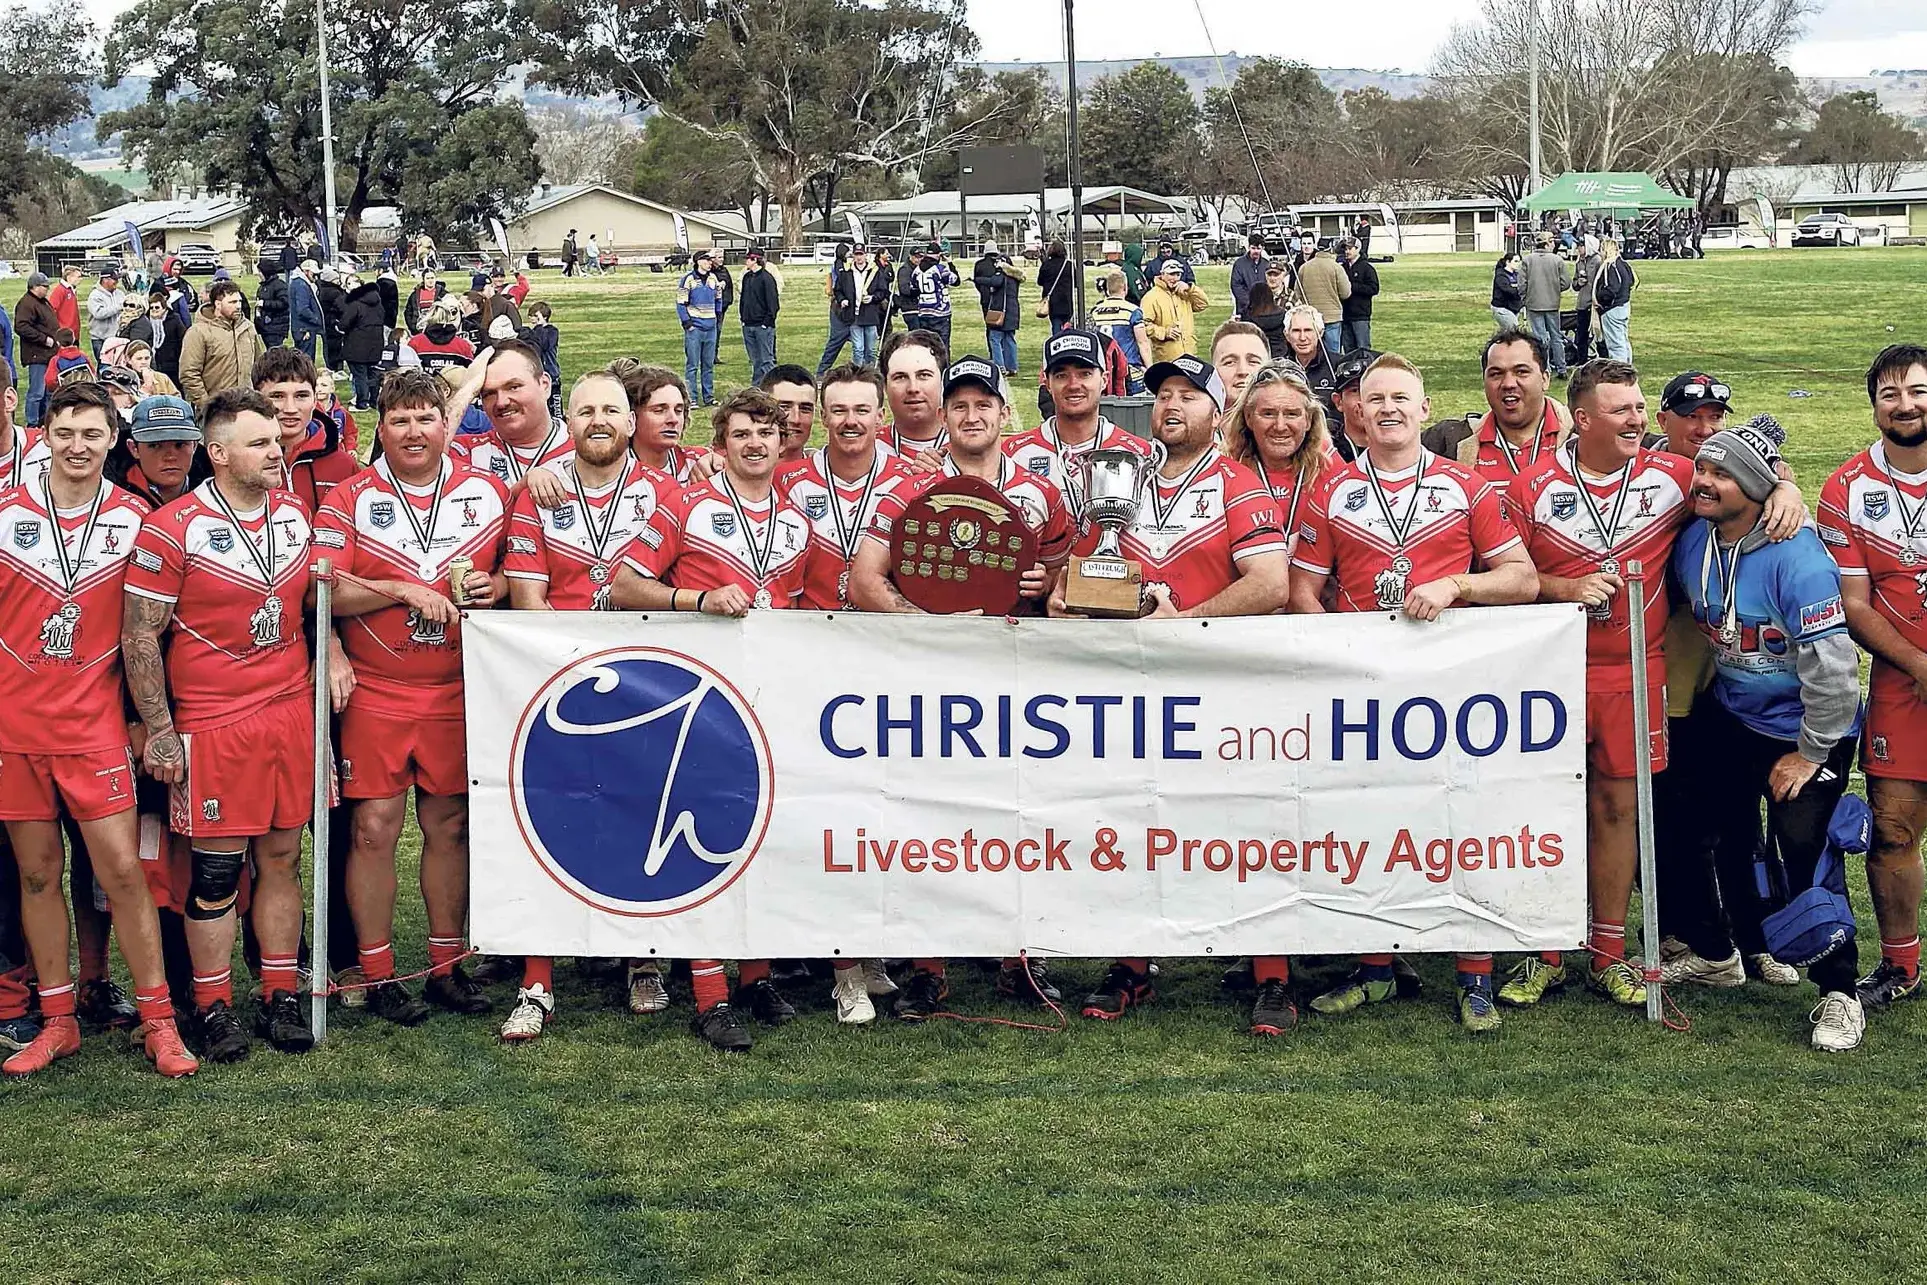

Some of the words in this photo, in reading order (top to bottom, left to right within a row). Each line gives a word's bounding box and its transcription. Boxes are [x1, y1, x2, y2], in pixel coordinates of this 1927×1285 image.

[917, 273, 935, 293] 15
[1741, 432, 1776, 460] ONLY
[1031, 457, 1049, 465] NSW
[1553, 494, 1576, 502] NSW
[1865, 493, 1885, 502] NSW
[371, 503, 393, 512] NSW
[554, 507, 573, 516] NSW
[713, 514, 734, 522] NSW
[1250, 509, 1278, 527] WL
[210, 529, 230, 538] NSW
[820, 694, 1202, 760] CHRISTIE
[1219, 714, 1312, 761] and
[1331, 690, 1568, 761] HOOD
[823, 828, 1072, 873] Livestock
[1090, 827, 1127, 872] &
[1146, 827, 1370, 885] Property
[1383, 824, 1564, 883] Agents
